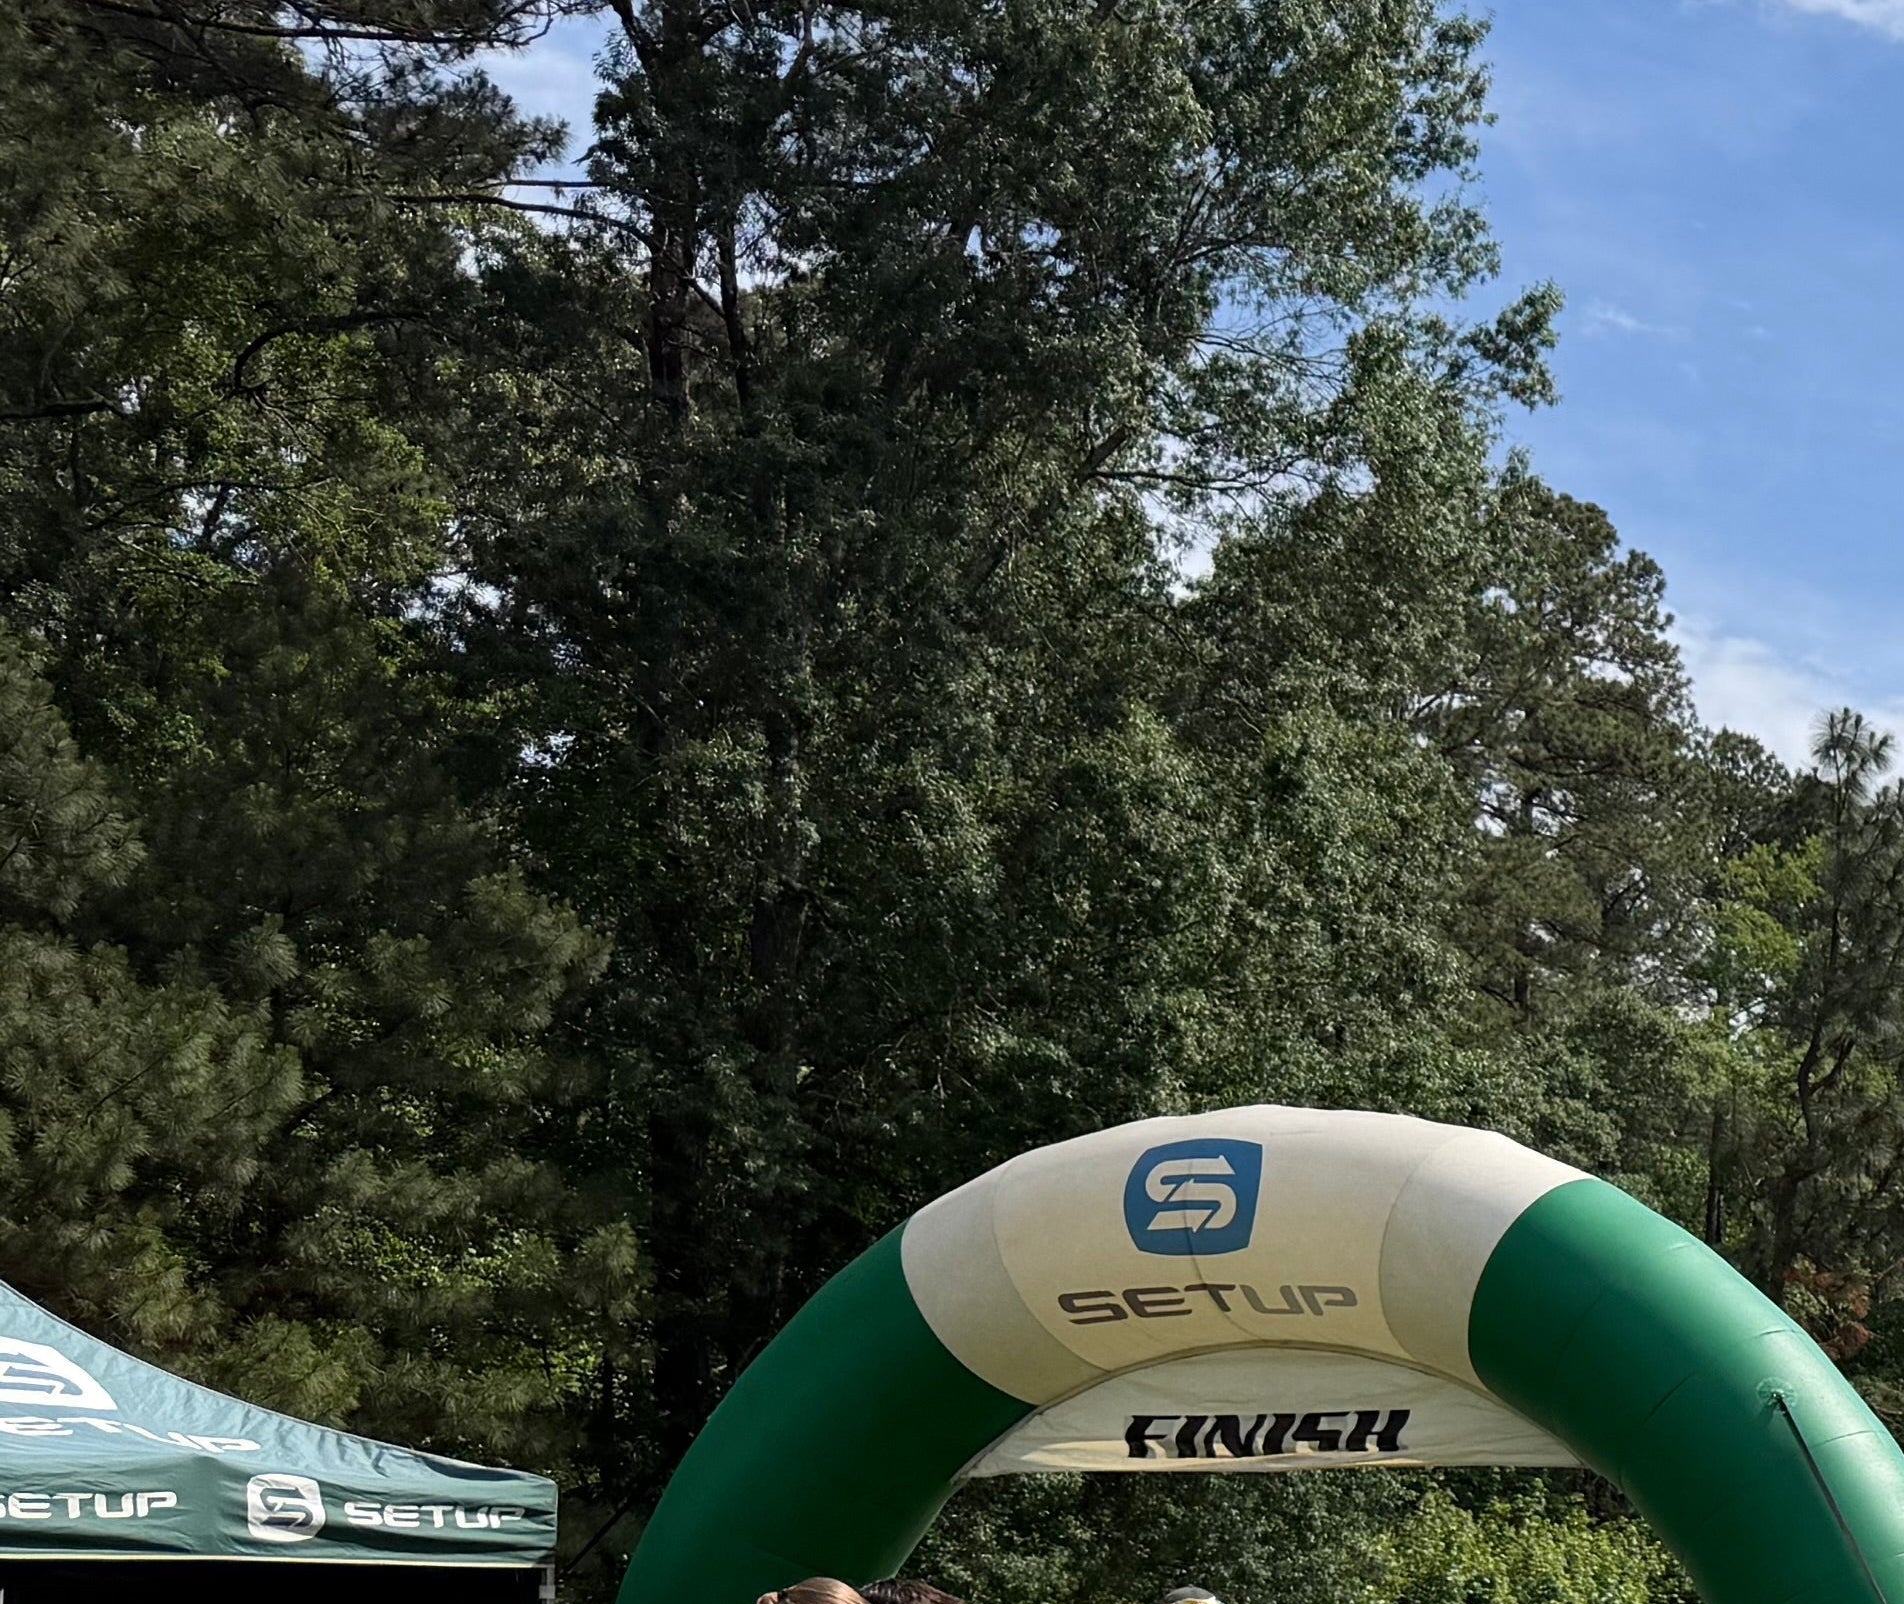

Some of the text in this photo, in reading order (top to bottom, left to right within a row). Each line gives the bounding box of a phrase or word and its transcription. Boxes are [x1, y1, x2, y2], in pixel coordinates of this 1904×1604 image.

[1057, 1284, 1358, 1325] SETUP
[0, 1416, 262, 1453] ETUP
[1125, 1409, 1411, 1458] FINISH
[0, 1491, 178, 1519] ETUP
[344, 1501, 526, 1529] SETUP
